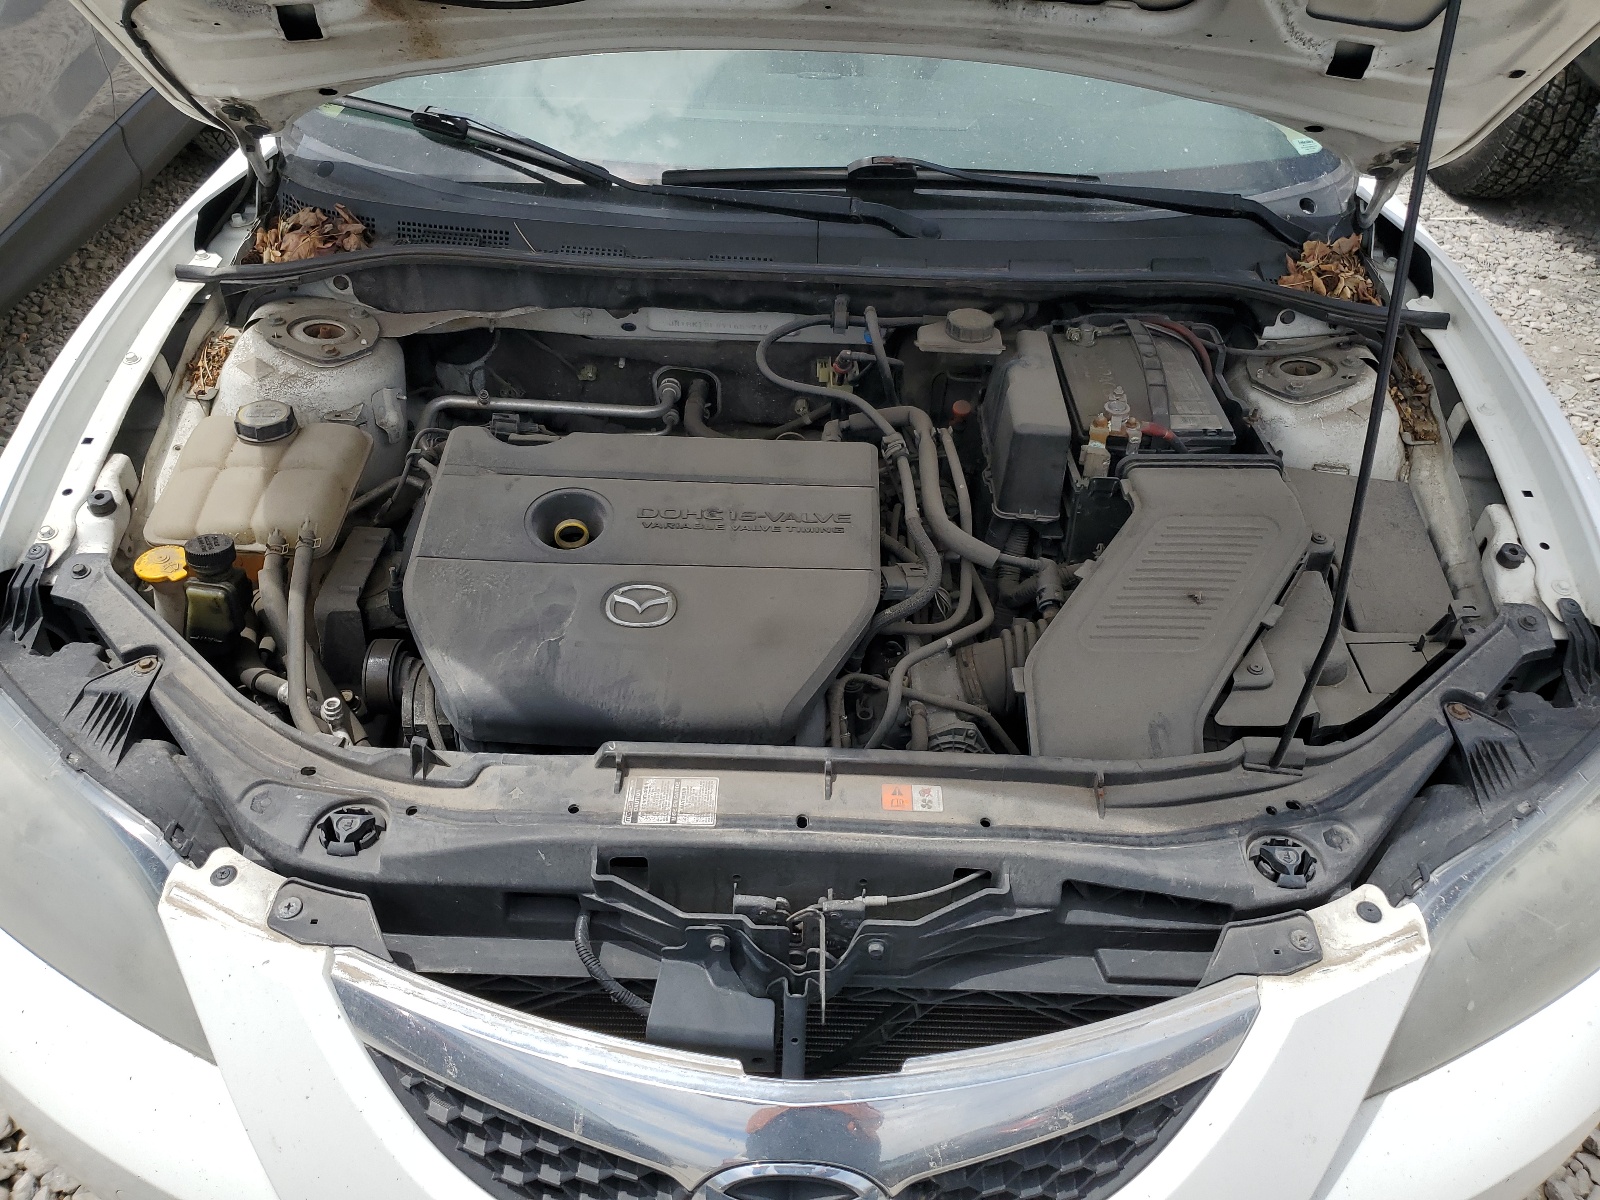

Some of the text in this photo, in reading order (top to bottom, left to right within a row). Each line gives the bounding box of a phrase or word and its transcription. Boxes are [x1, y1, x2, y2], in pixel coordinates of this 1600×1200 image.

[637, 508, 852, 524] DOHC 16-VALVE
[641, 521, 845, 534] VARIABLE VALVE TIMING
